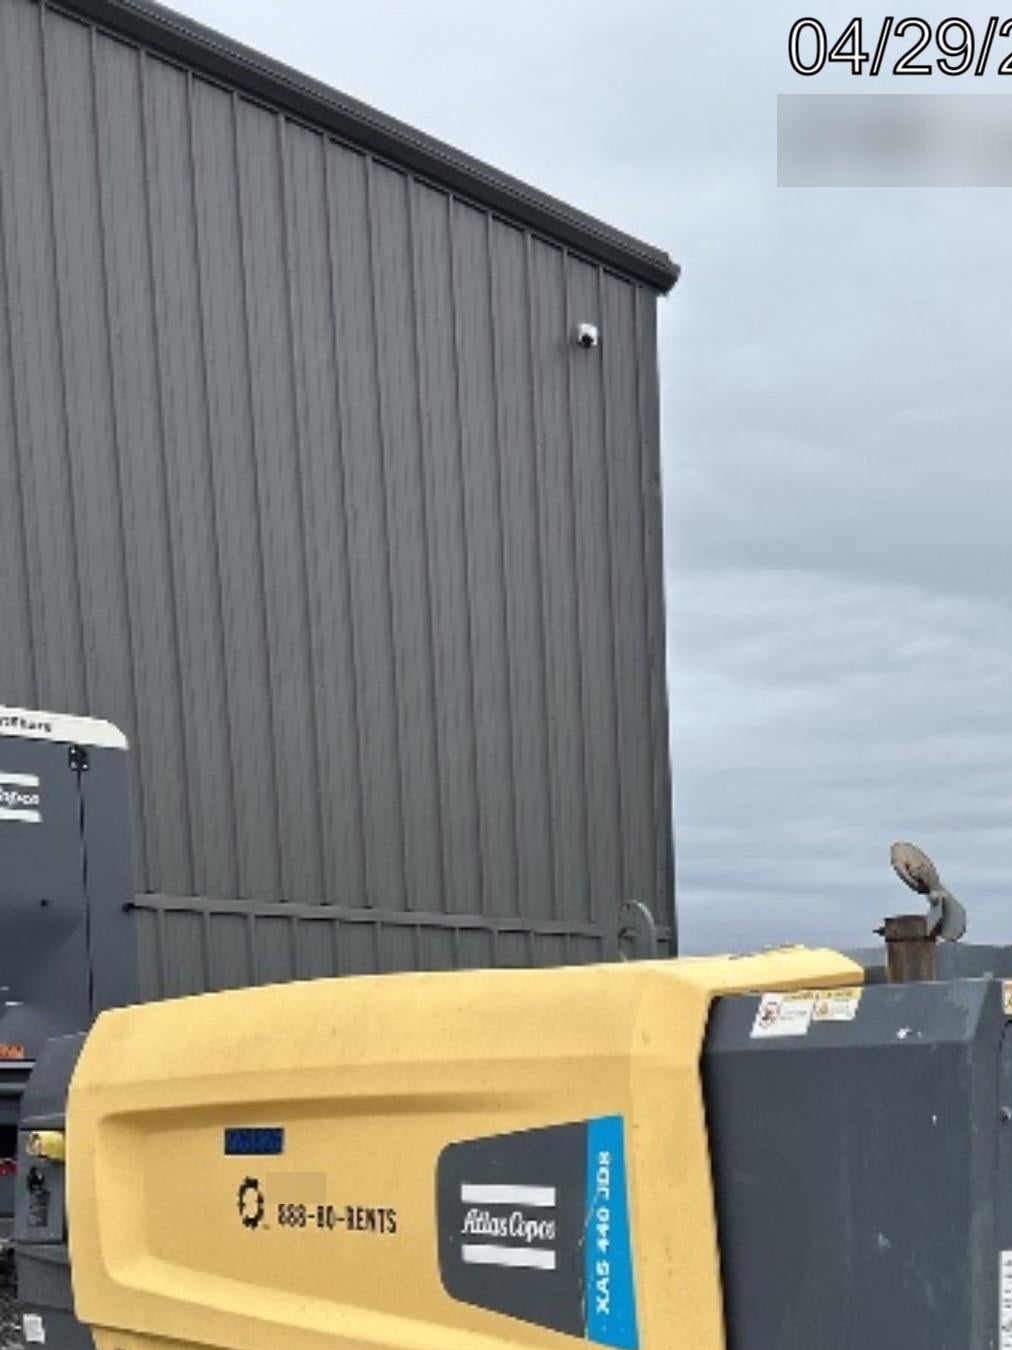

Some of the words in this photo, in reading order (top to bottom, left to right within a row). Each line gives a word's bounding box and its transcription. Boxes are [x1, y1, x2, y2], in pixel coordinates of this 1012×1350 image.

[460, 1208, 508, 1236] Atlas
[508, 1211, 556, 1242] Copco
[597, 1207, 611, 1253] 440
[596, 1260, 611, 1315] XAS
